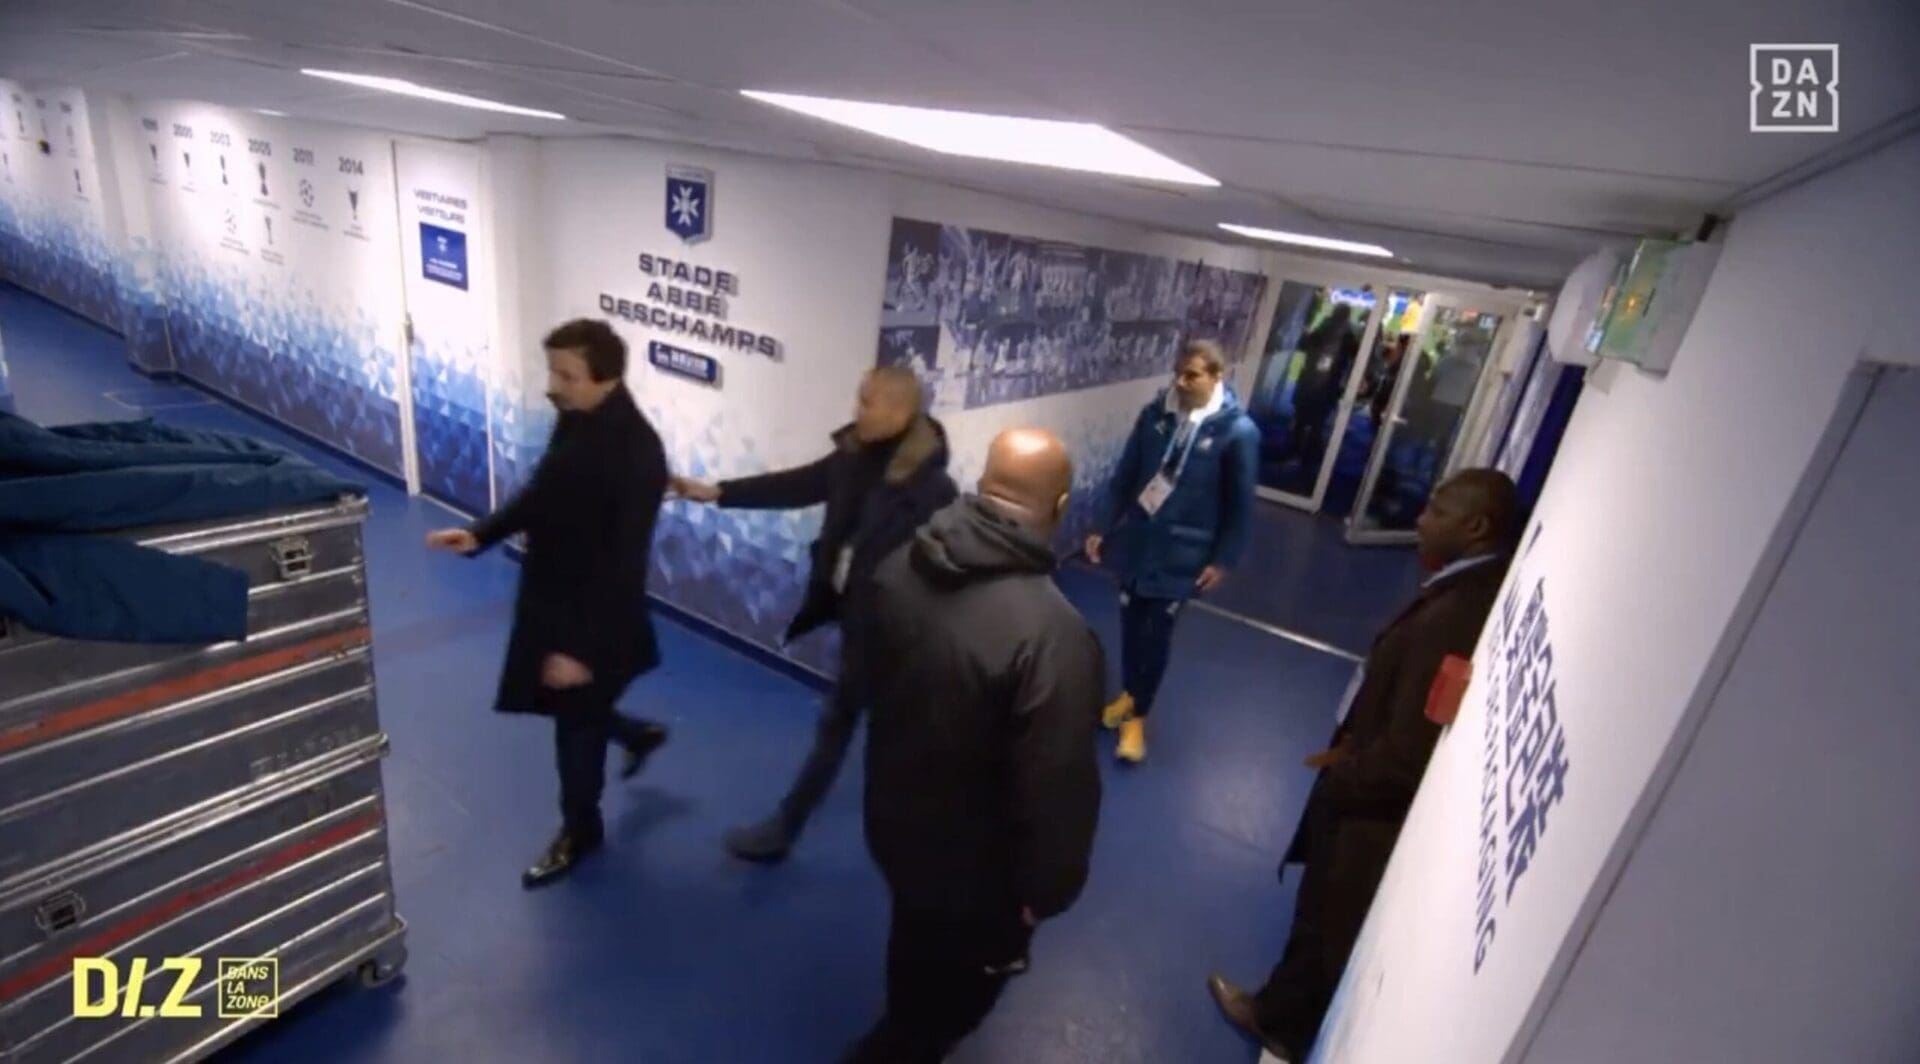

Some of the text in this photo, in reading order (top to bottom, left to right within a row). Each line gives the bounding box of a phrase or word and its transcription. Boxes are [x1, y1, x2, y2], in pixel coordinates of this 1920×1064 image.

[338, 156, 364, 176] 2014
[638, 252, 734, 294] STADE
[599, 292, 779, 360] DESCHAMPS
